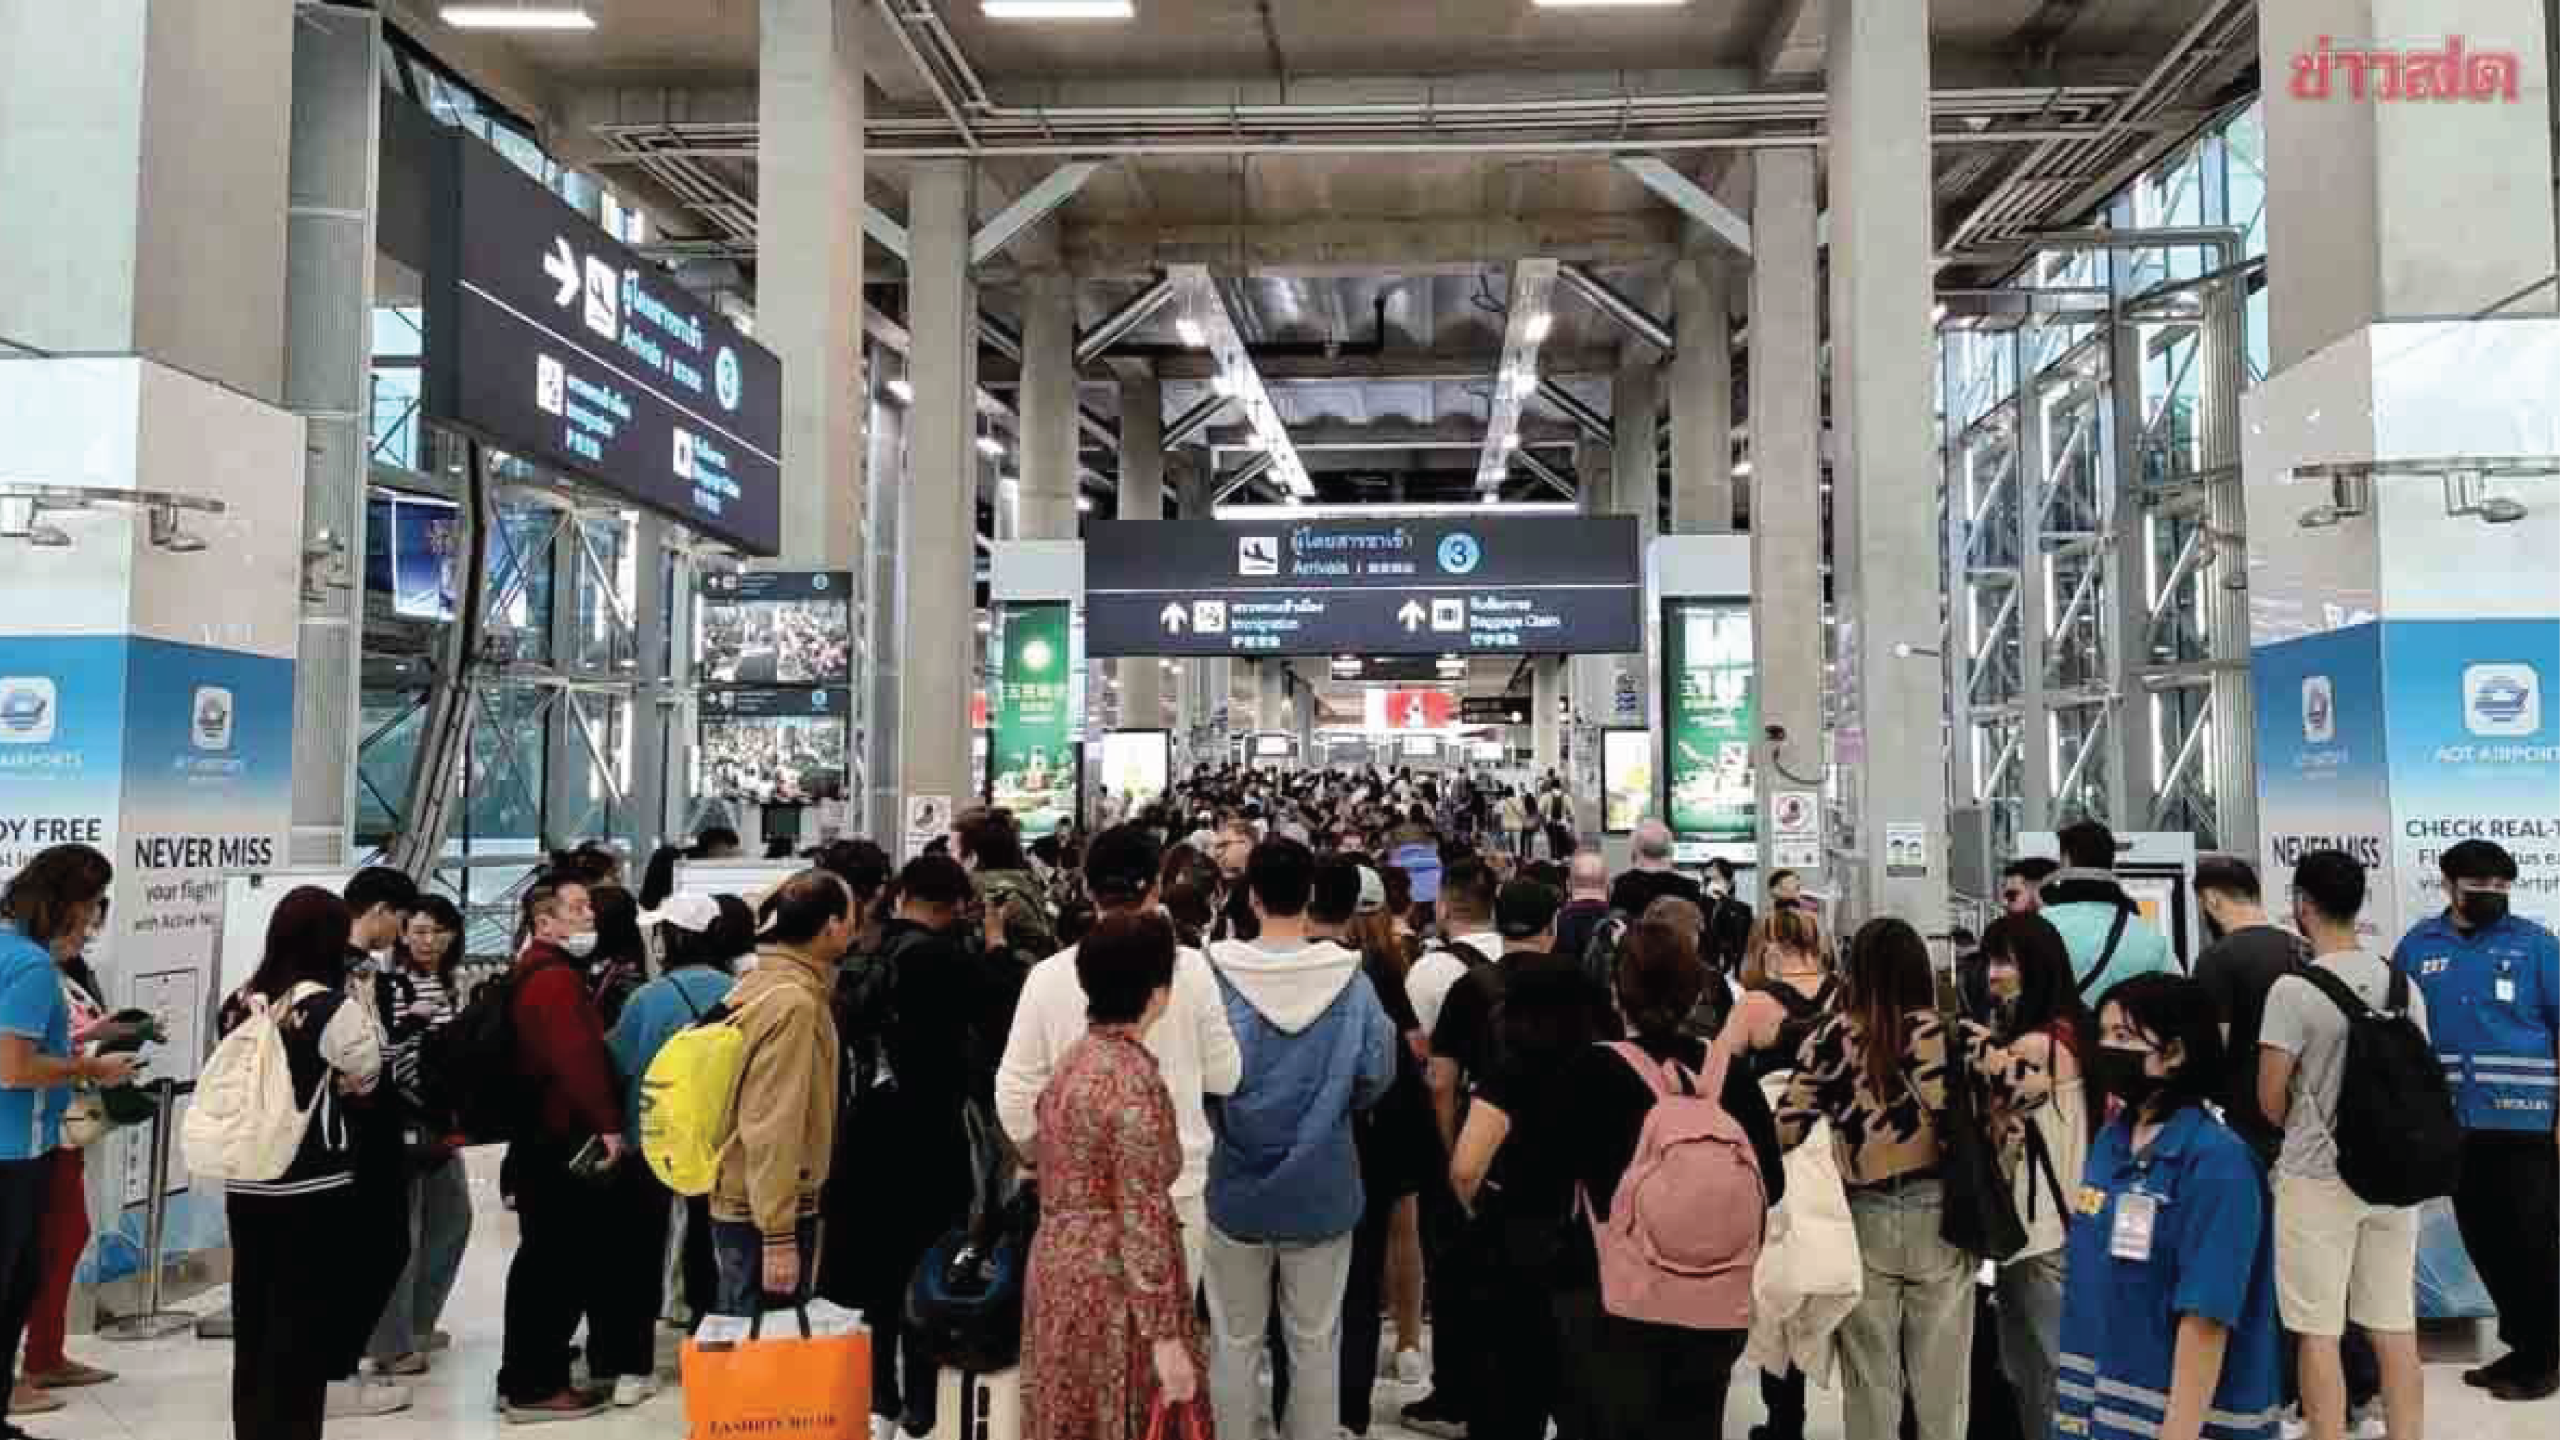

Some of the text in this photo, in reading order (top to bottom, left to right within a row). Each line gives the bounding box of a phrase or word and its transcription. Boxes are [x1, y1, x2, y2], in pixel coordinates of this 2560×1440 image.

[1292, 560, 1349, 575] Arrivals
[33, 818, 102, 842] FREE
[2405, 818, 2484, 837] CHECK
[135, 837, 274, 869] NEVER MISS
